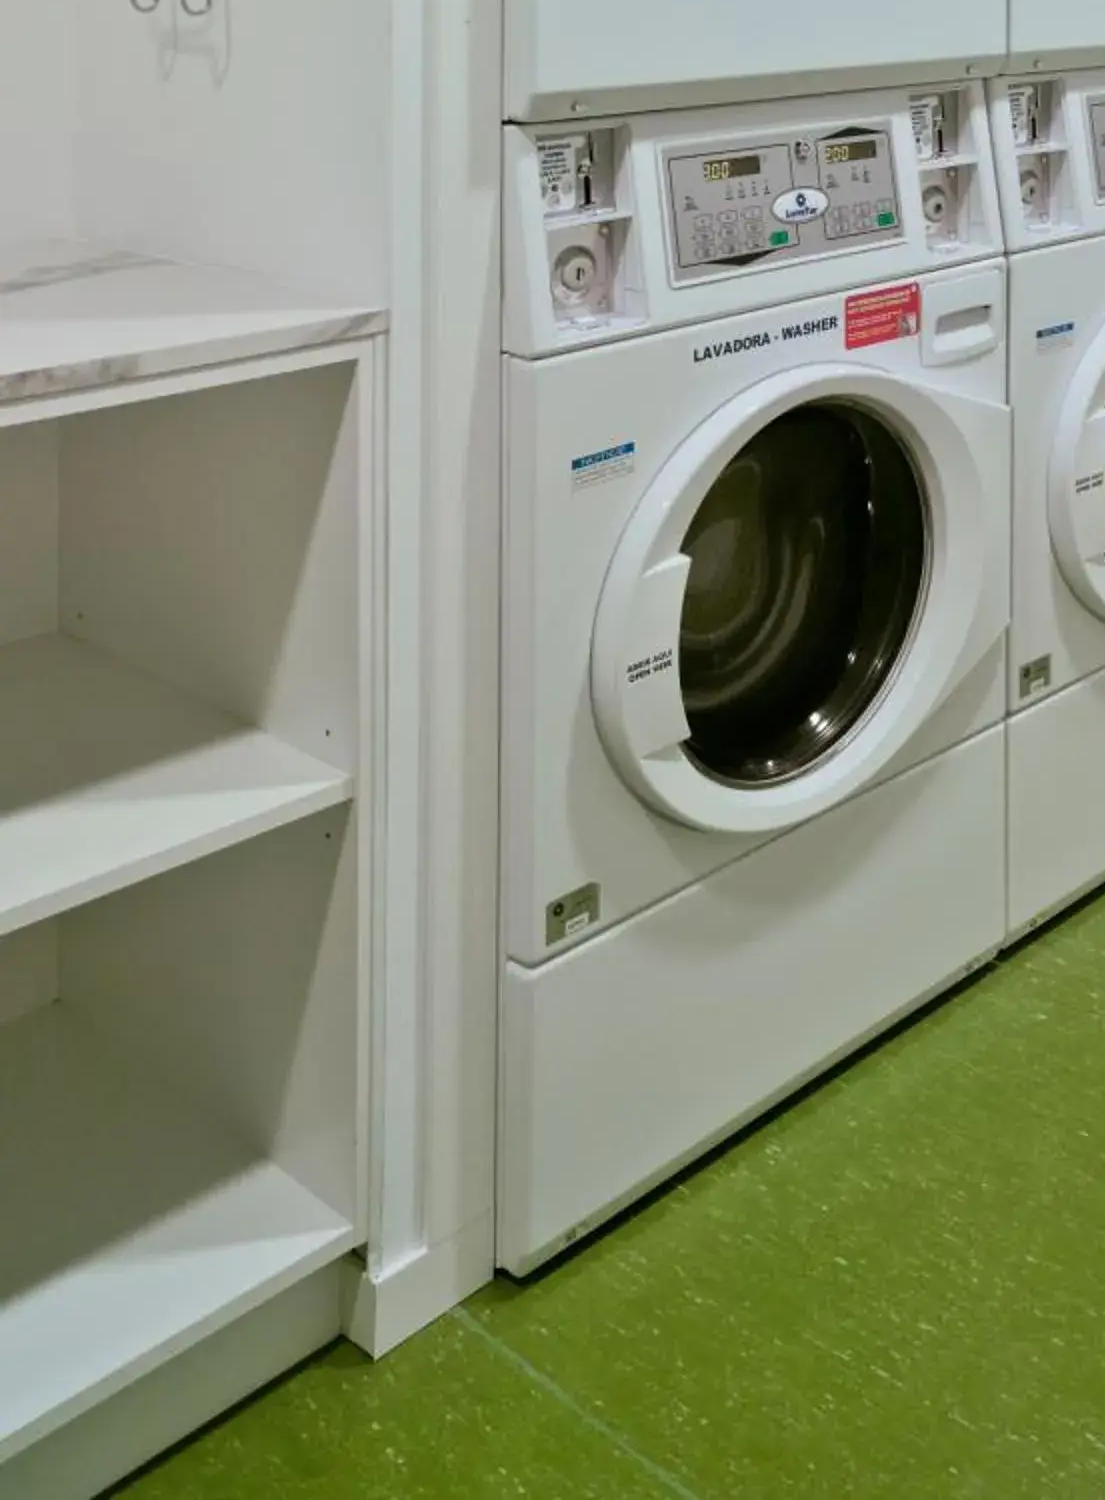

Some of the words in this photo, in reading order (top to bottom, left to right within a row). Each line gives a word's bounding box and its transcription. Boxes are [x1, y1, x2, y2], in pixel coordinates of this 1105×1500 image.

[693, 332, 771, 363] LAVADORA
[781, 315, 839, 341] WASHER
[628, 668, 650, 683] OPEN
